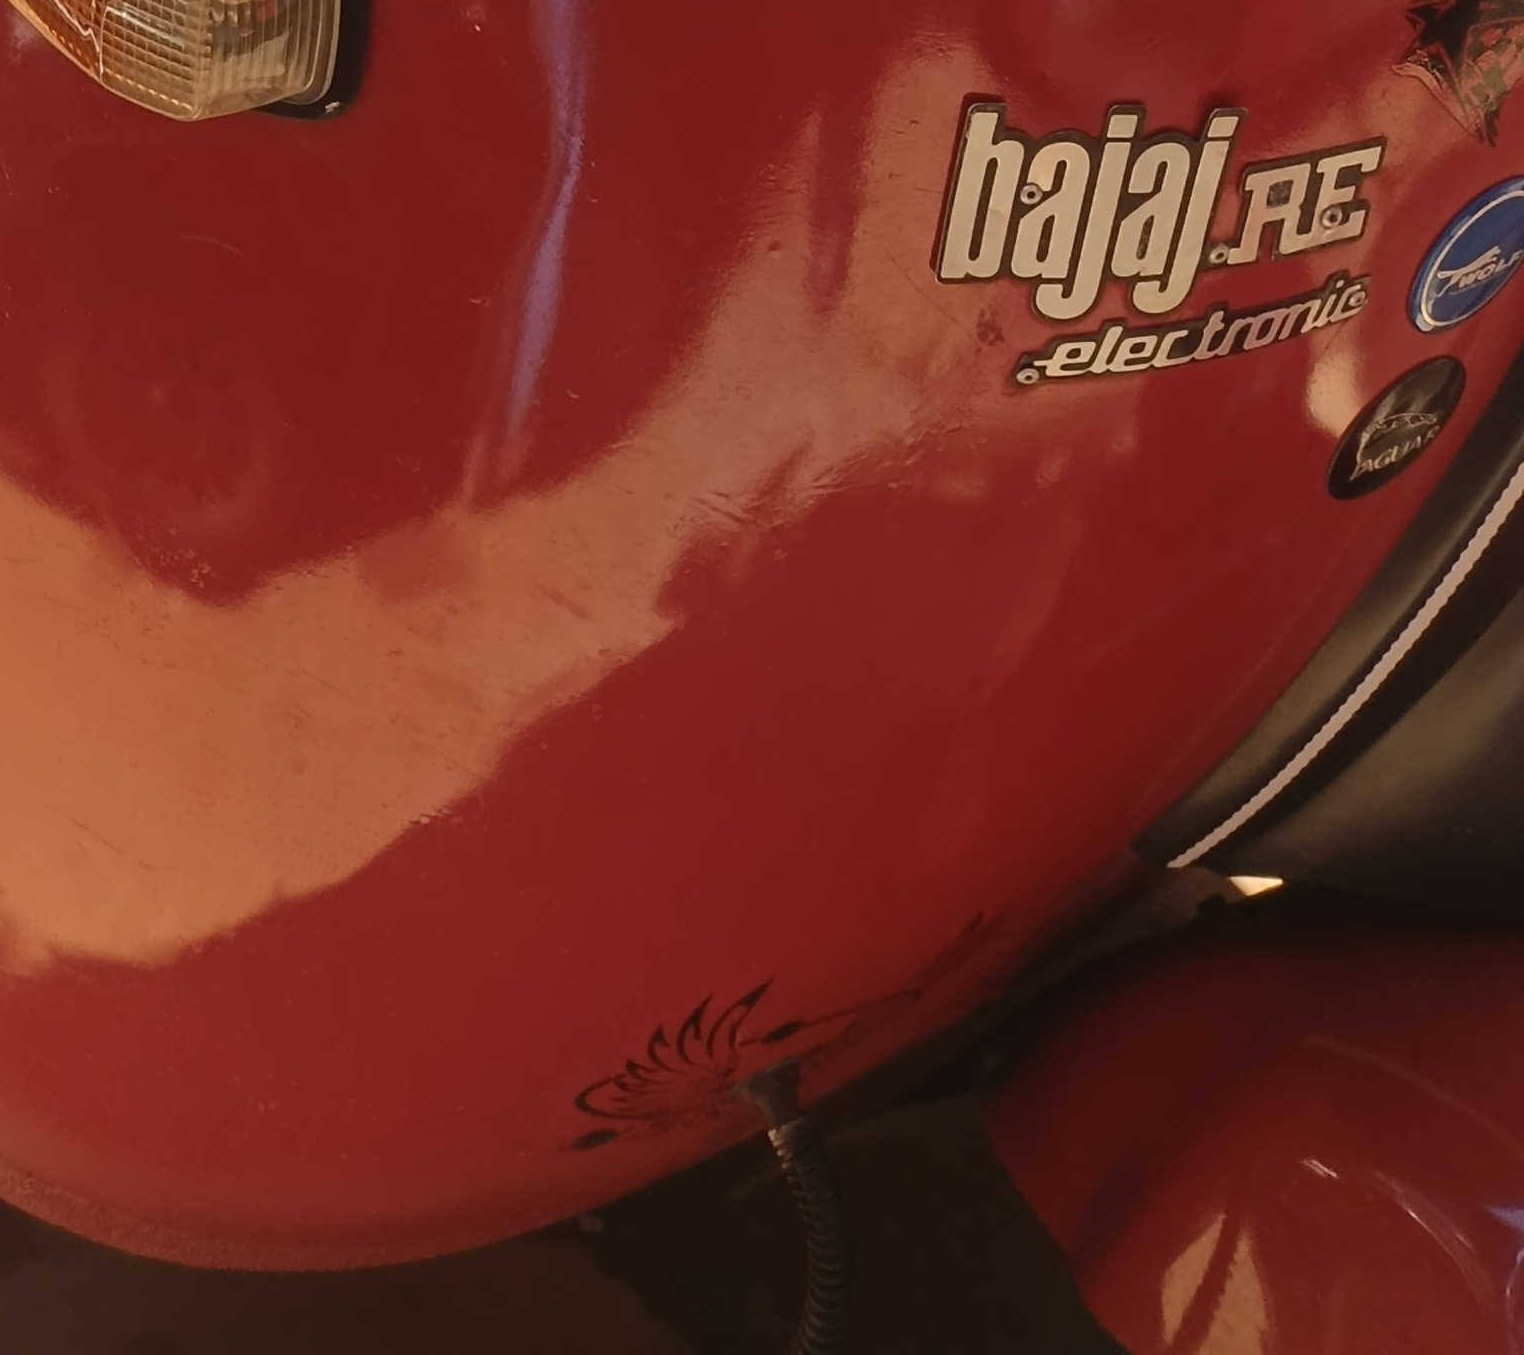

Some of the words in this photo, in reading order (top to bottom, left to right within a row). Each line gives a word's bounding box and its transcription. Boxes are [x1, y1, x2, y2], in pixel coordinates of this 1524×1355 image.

[939, 103, 1239, 320] bajaj
[1457, 249, 1524, 290] WOLF
[1033, 279, 1369, 378] electronic
